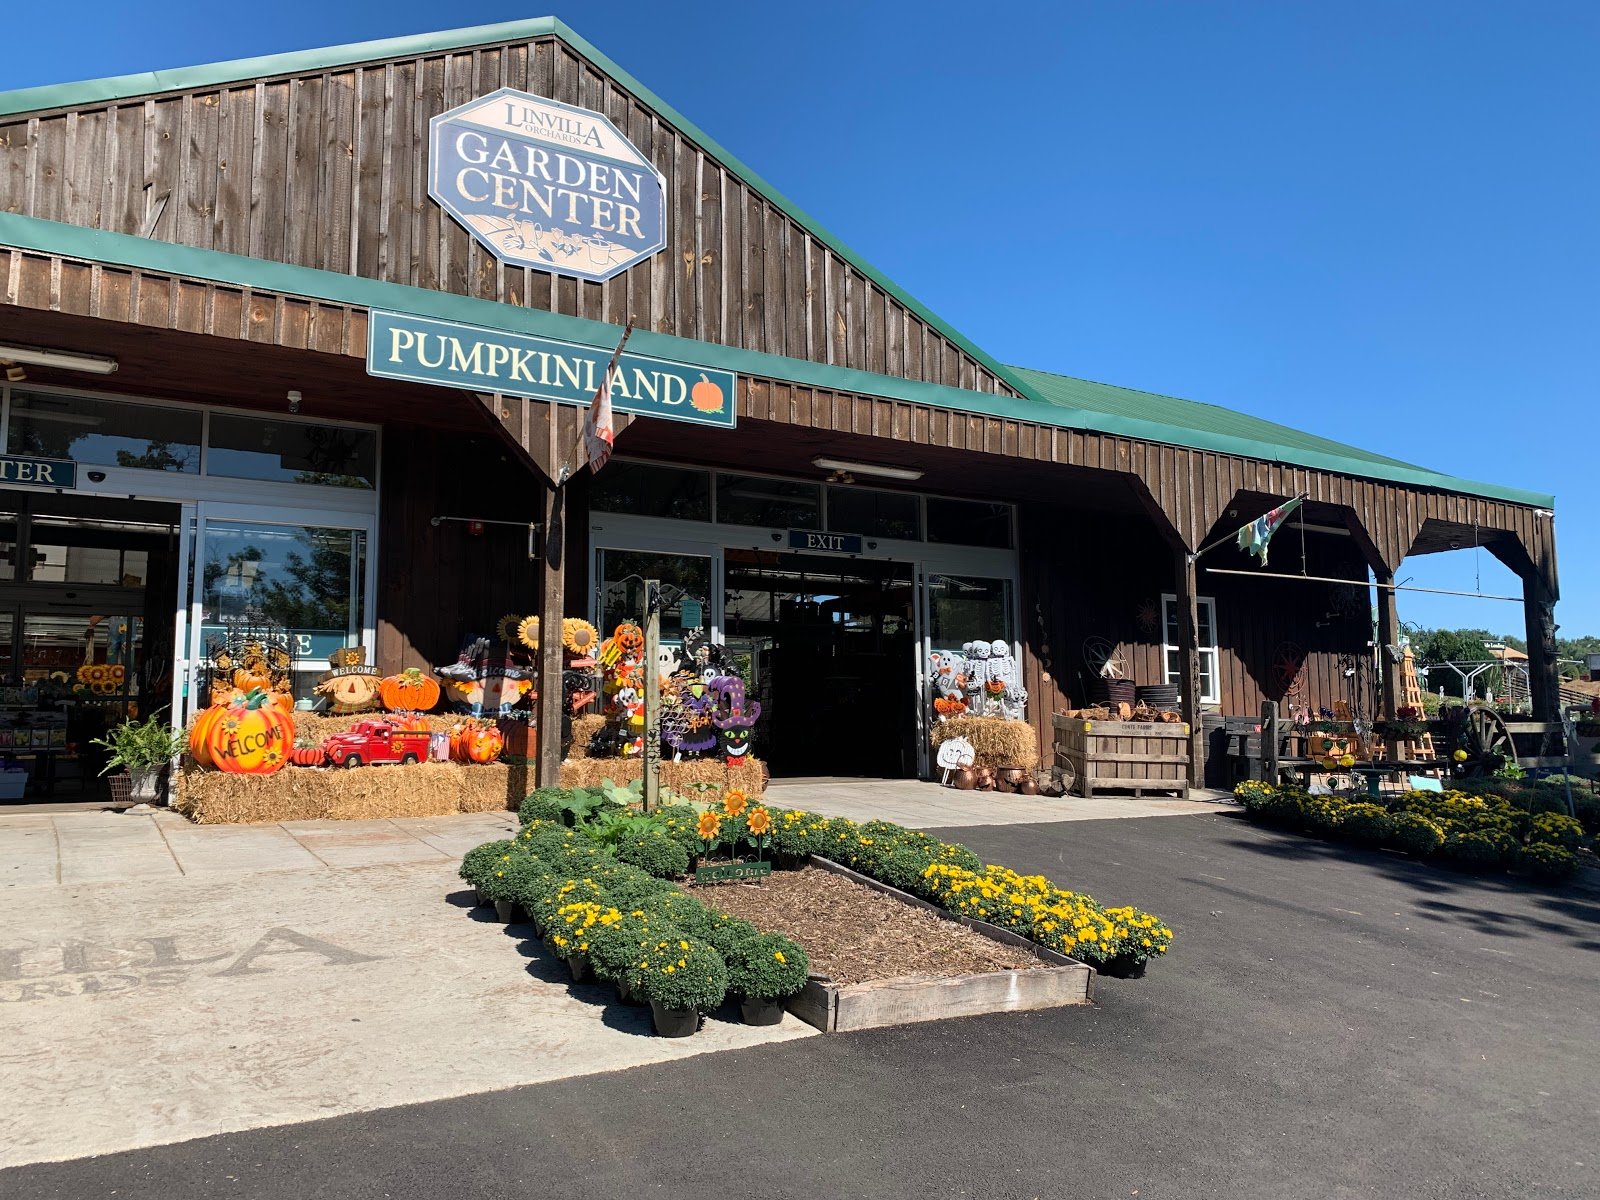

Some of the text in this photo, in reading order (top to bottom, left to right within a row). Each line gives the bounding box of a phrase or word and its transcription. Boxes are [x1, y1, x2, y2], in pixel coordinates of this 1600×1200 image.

[505, 102, 605, 149] LINVILLA
[525, 124, 582, 145] ORCHARDS
[456, 131, 643, 204] GARDEN
[456, 167, 646, 239] CENTER
[388, 327, 687, 405] PUMPKINLAND
[0, 460, 55, 483] TER
[806, 534, 845, 550] EXIT
[331, 665, 378, 677] WELCOME
[214, 724, 283, 760] WELCOME
